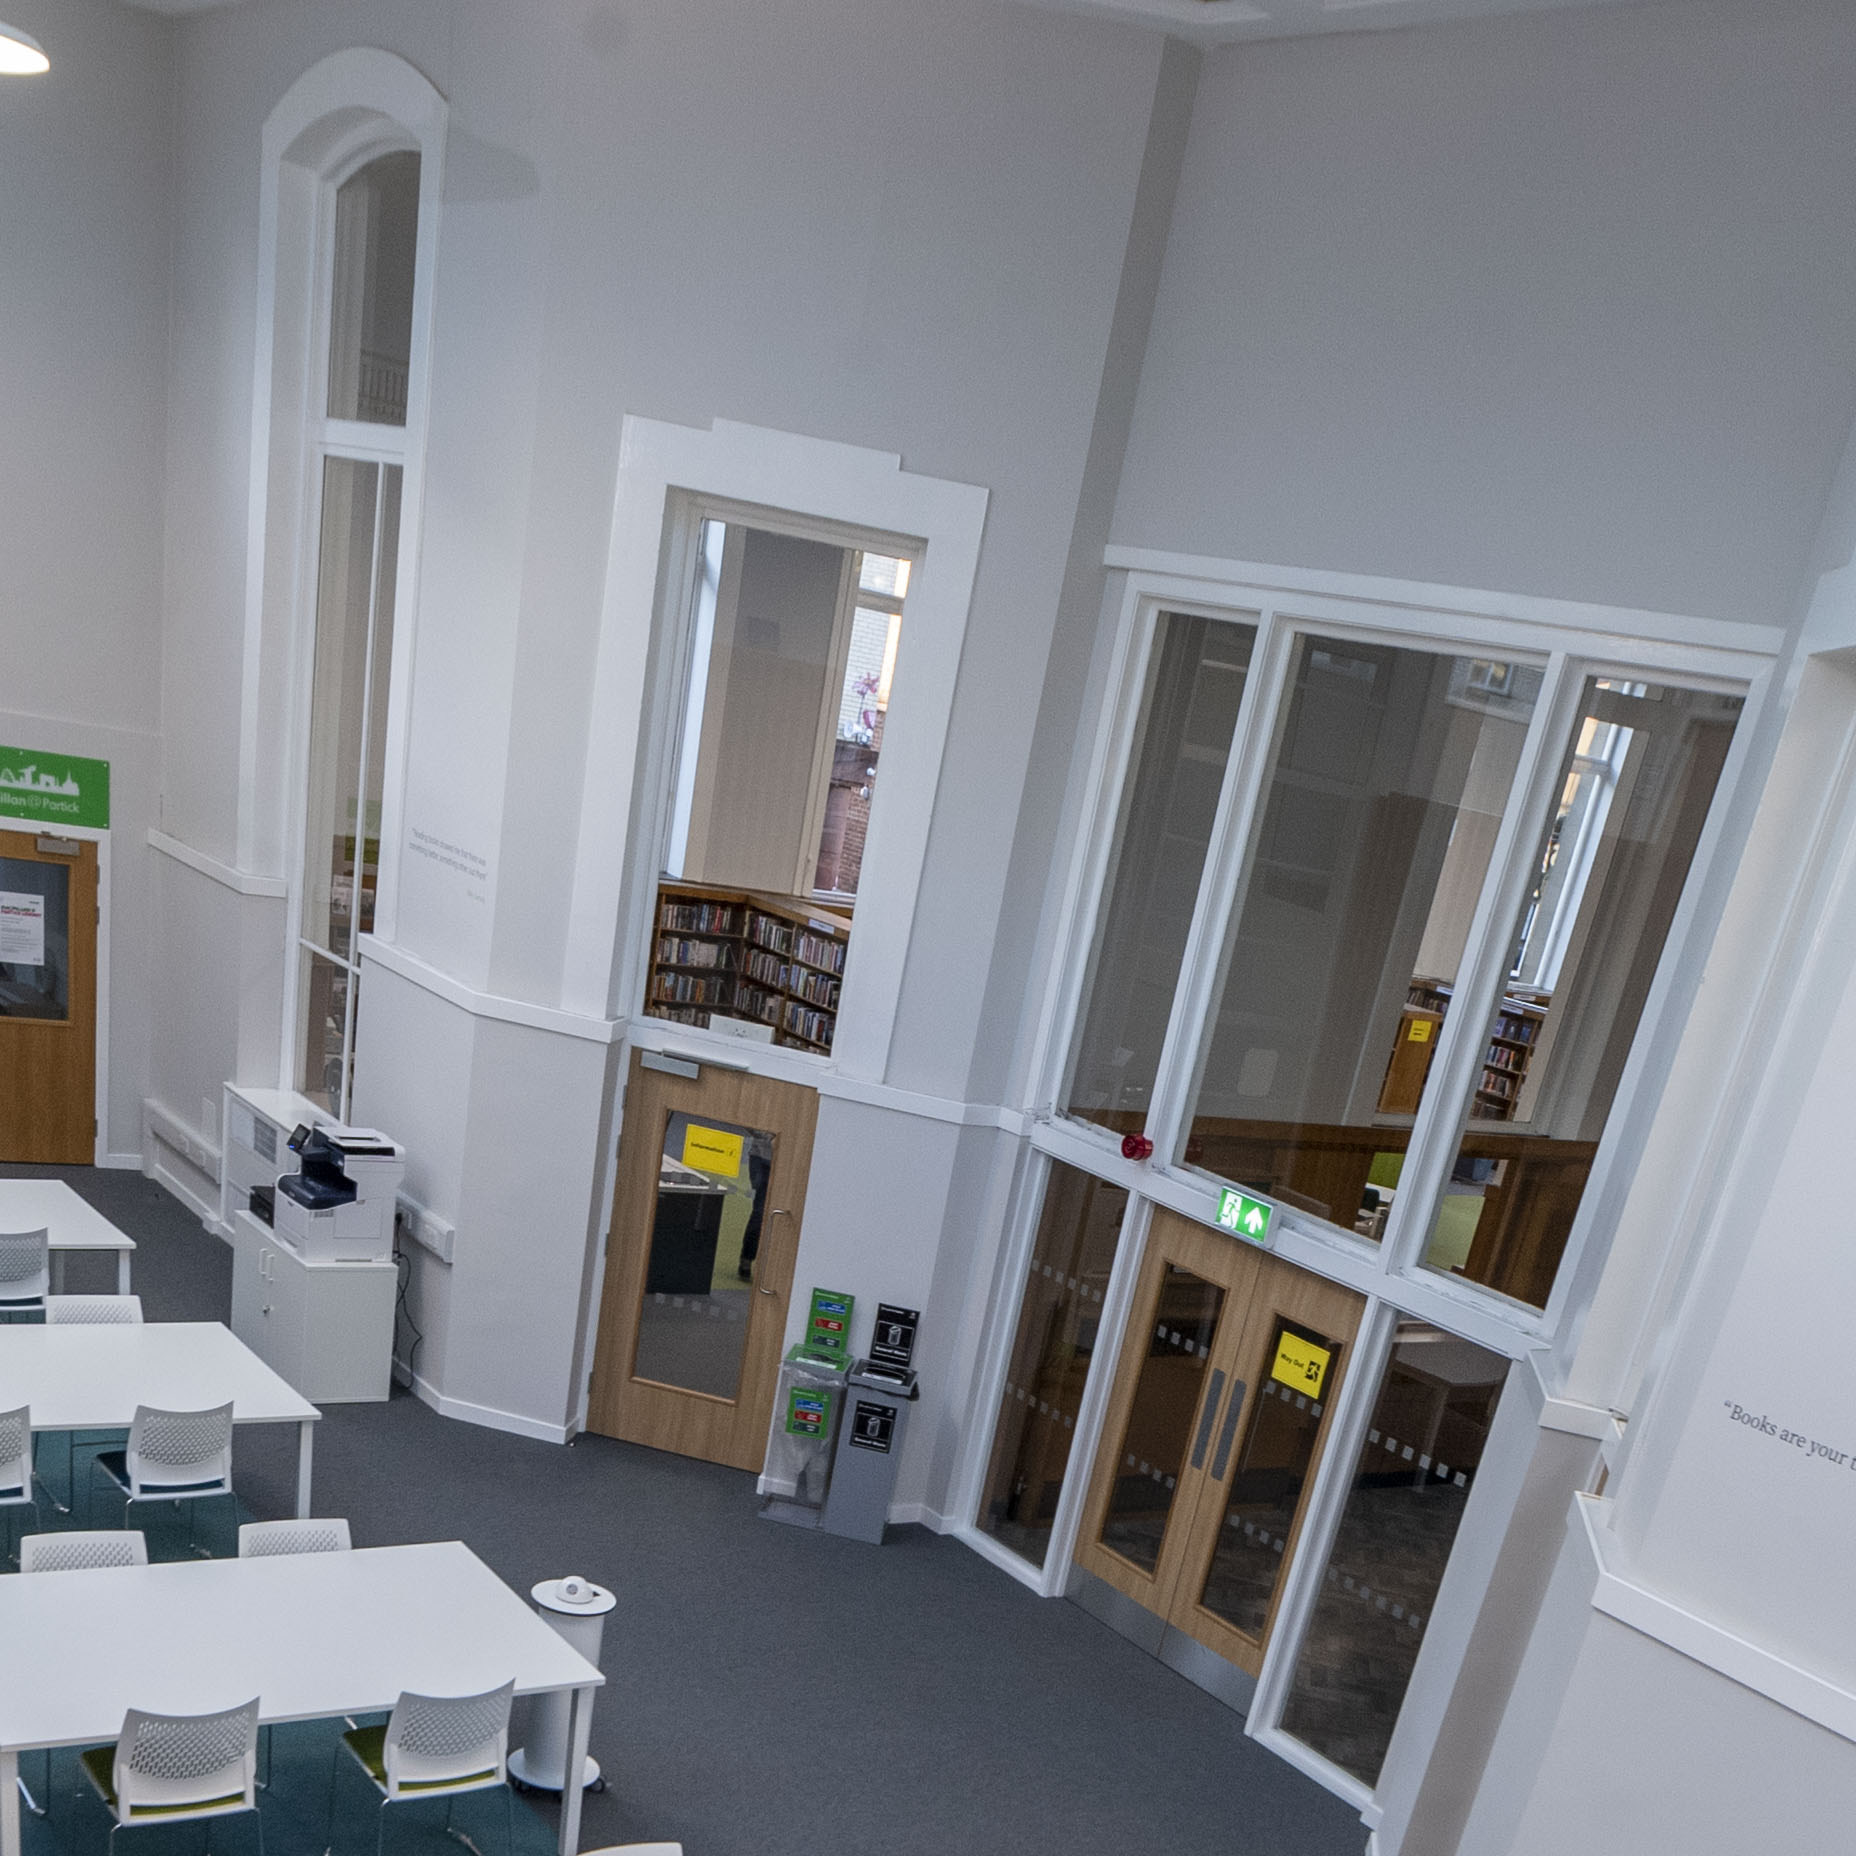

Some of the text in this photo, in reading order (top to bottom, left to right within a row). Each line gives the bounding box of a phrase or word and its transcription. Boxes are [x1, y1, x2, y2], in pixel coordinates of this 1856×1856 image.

[42, 798, 80, 814] Partick
[1779, 1427, 1807, 1448] are
[1805, 1440, 1849, 1465] your
